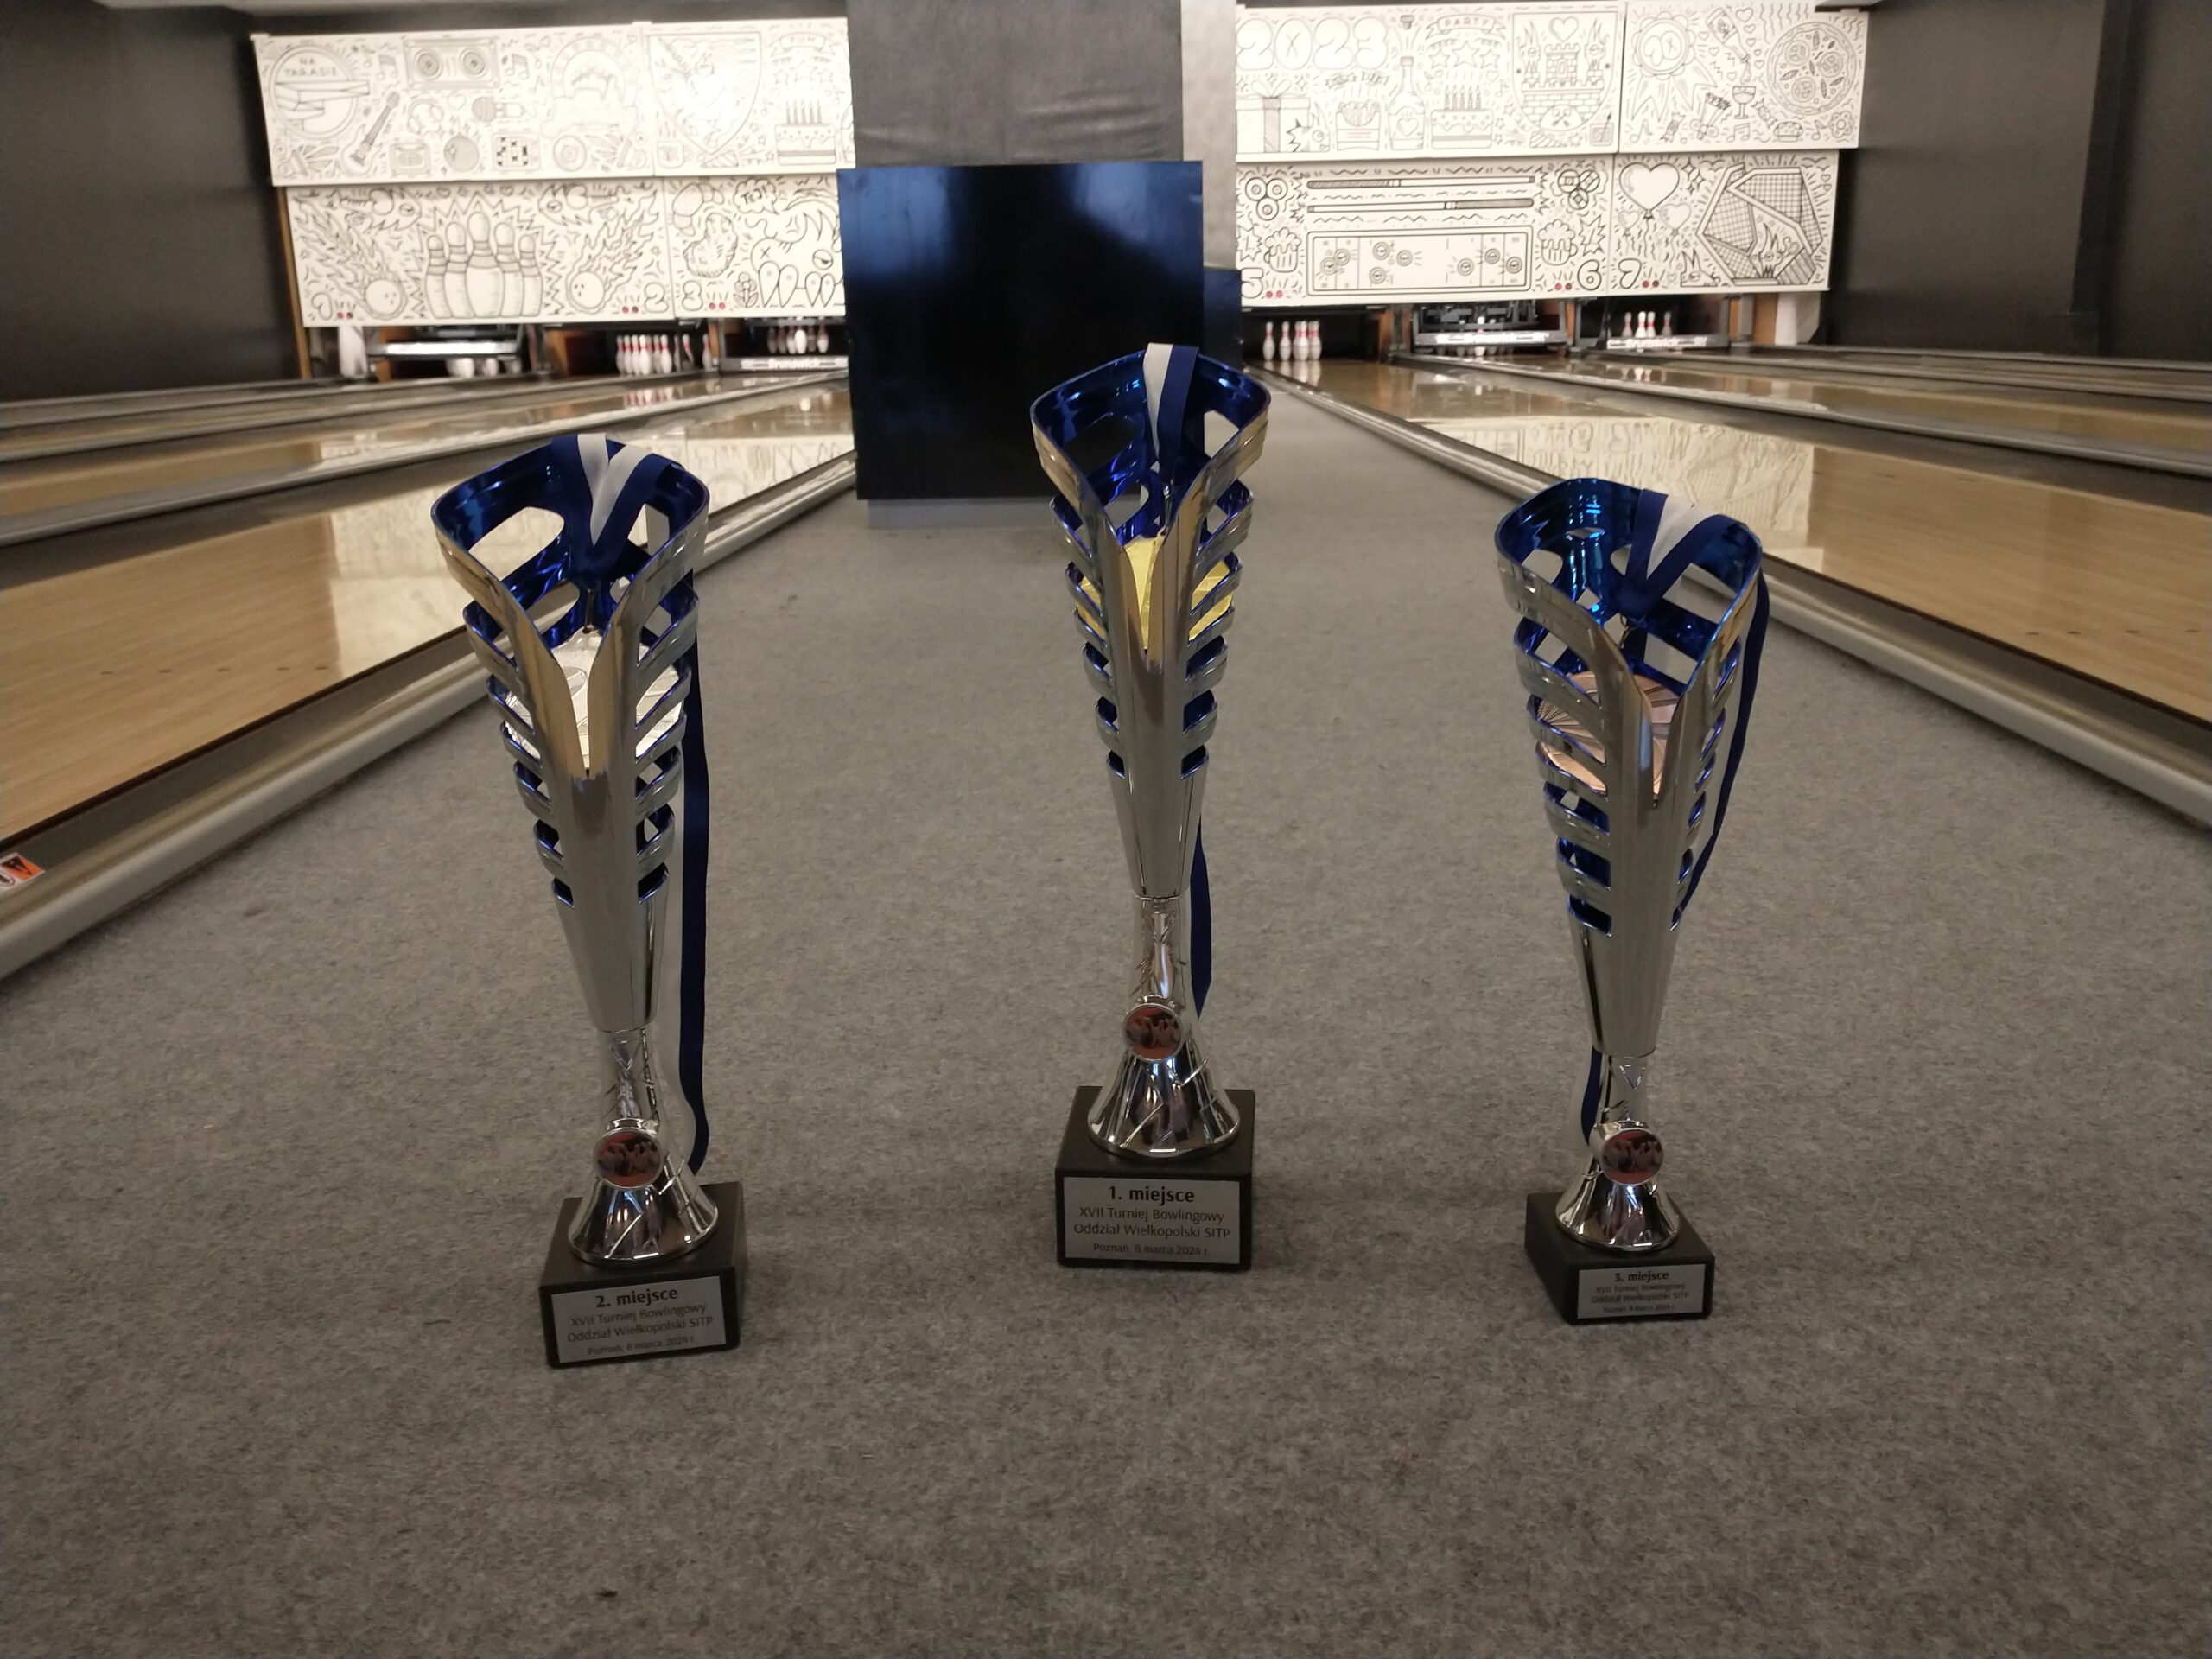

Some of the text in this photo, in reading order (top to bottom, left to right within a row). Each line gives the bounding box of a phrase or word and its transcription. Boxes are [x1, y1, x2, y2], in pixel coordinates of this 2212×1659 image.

[1444, 16, 1489, 27] PARTY
[283, 67, 337, 78] TARASIE
[1241, 267, 1264, 299] 5
[1577, 259, 1603, 291] 6
[1618, 257, 1642, 289] 7
[644, 282, 670, 313] 2
[681, 280, 704, 311] 3
[1108, 1185, 1195, 1207] 1. miejsce
[1079, 1206, 1224, 1225] XVII Turniej Bowlingowy
[1074, 1222, 1231, 1240] Oddział Wielkopolski SITP
[1143, 1245, 1173, 1255] marca
[1614, 1270, 1670, 1283] 3. miejsce
[595, 1287, 678, 1308] 2. miejsce
[570, 1304, 707, 1327] XVII Turniej Bowlingowy
[567, 1316, 714, 1343] Oddział Wielkopolski SITP
